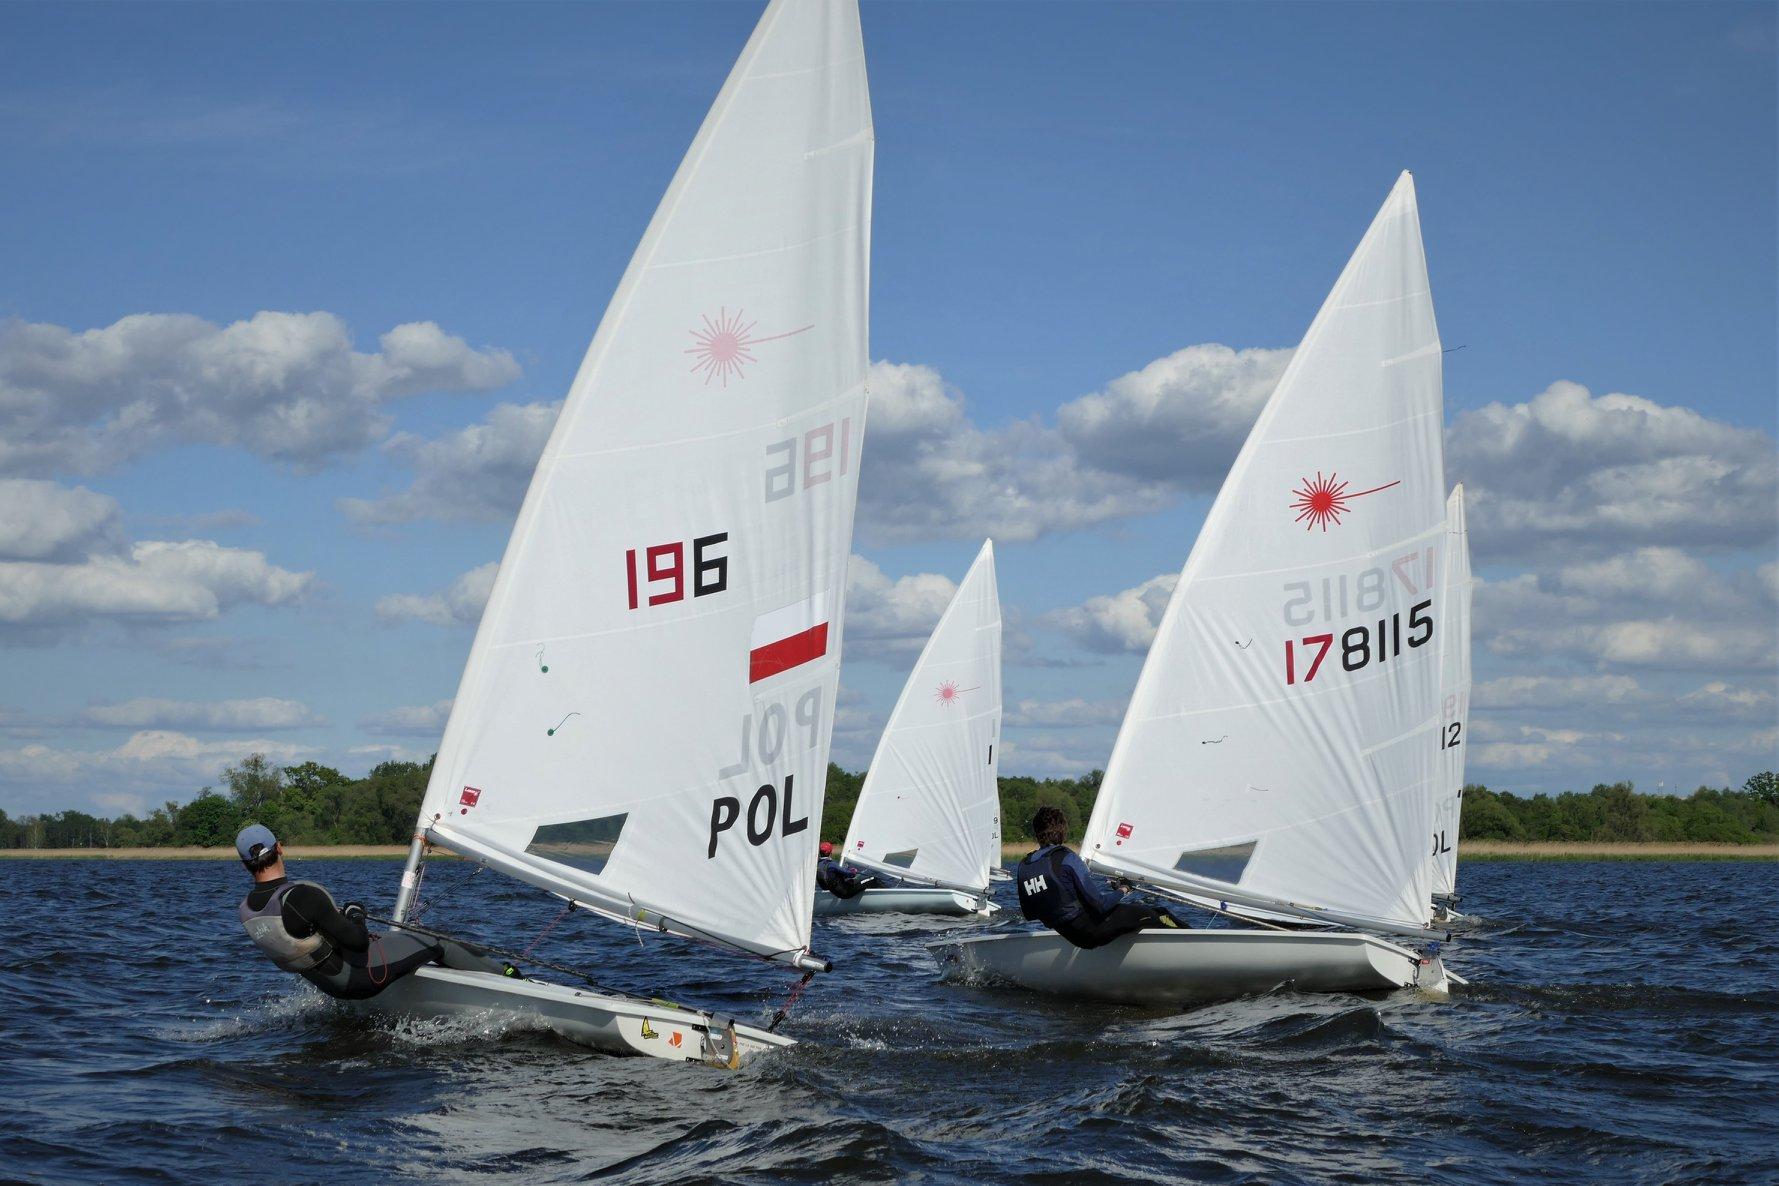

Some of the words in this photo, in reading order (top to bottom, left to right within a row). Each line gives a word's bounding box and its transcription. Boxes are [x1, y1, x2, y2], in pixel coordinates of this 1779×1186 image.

[625, 531, 729, 611] 196
[1285, 598, 1434, 686] 178115
[707, 773, 809, 860] POL
[1023, 874, 1048, 897] HH
